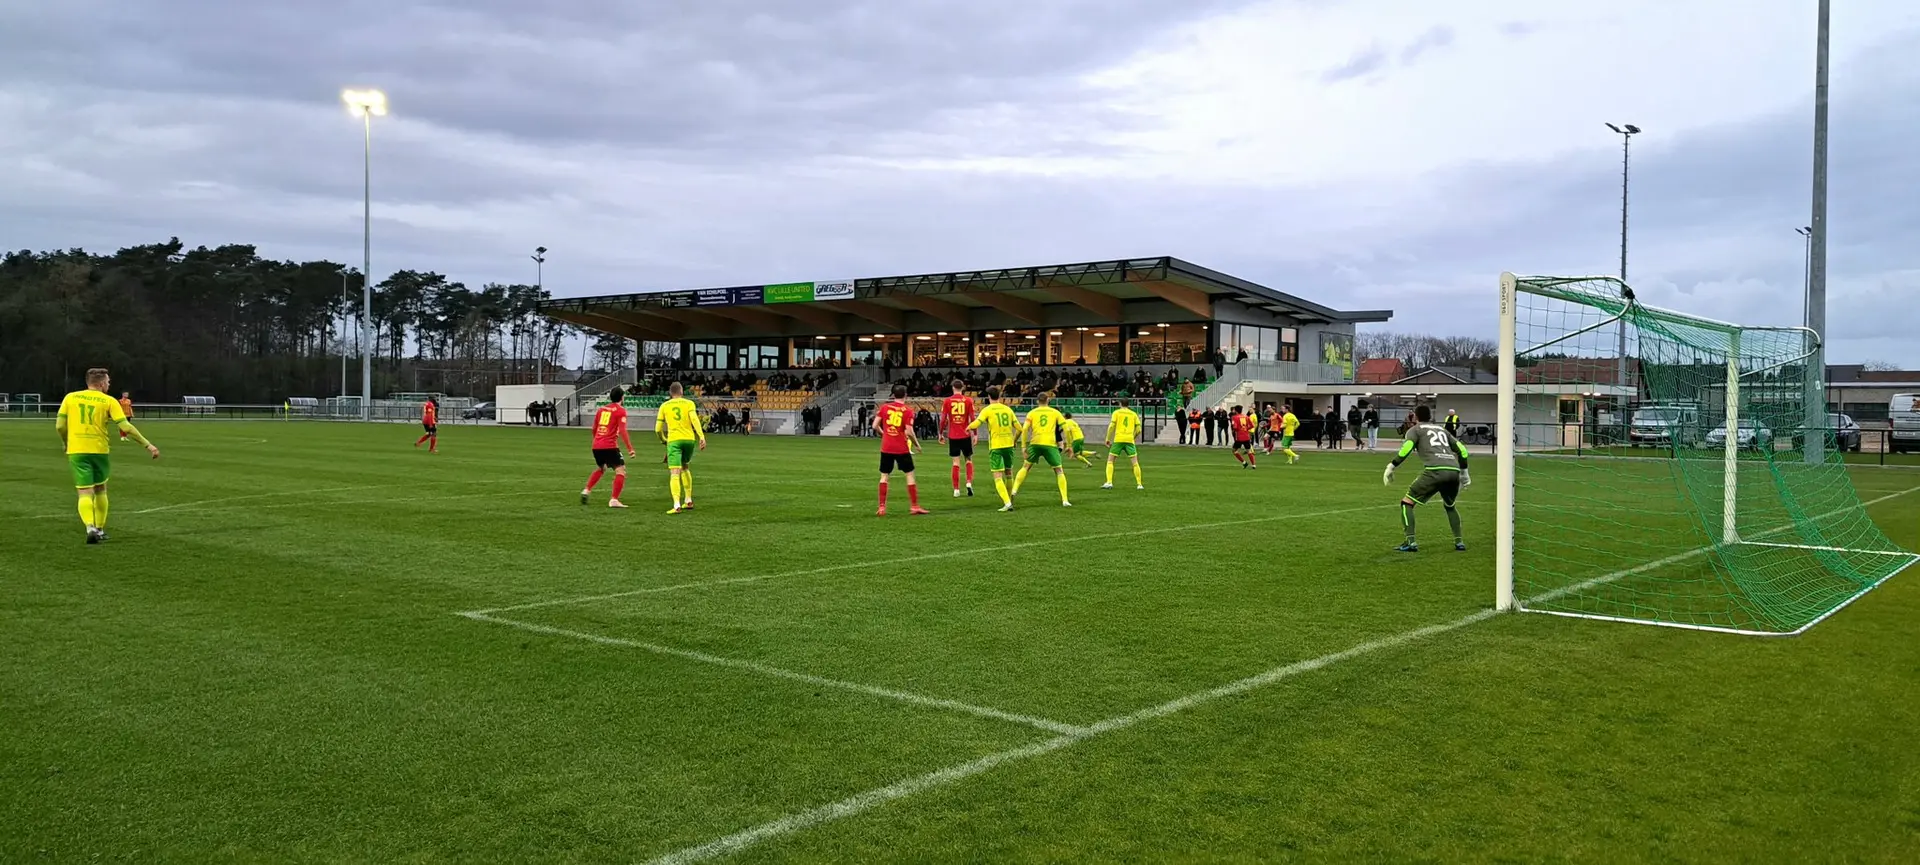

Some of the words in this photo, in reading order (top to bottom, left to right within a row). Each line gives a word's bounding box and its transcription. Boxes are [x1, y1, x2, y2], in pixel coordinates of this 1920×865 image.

[792, 285, 811, 293] UNITED
[672, 406, 682, 421] 3
[951, 402, 966, 415] 20
[886, 409, 904, 427] 36
[995, 412, 1009, 427] 18
[1039, 414, 1048, 427] 6
[1122, 416, 1129, 428] 4
[1426, 430, 1450, 447] 20
